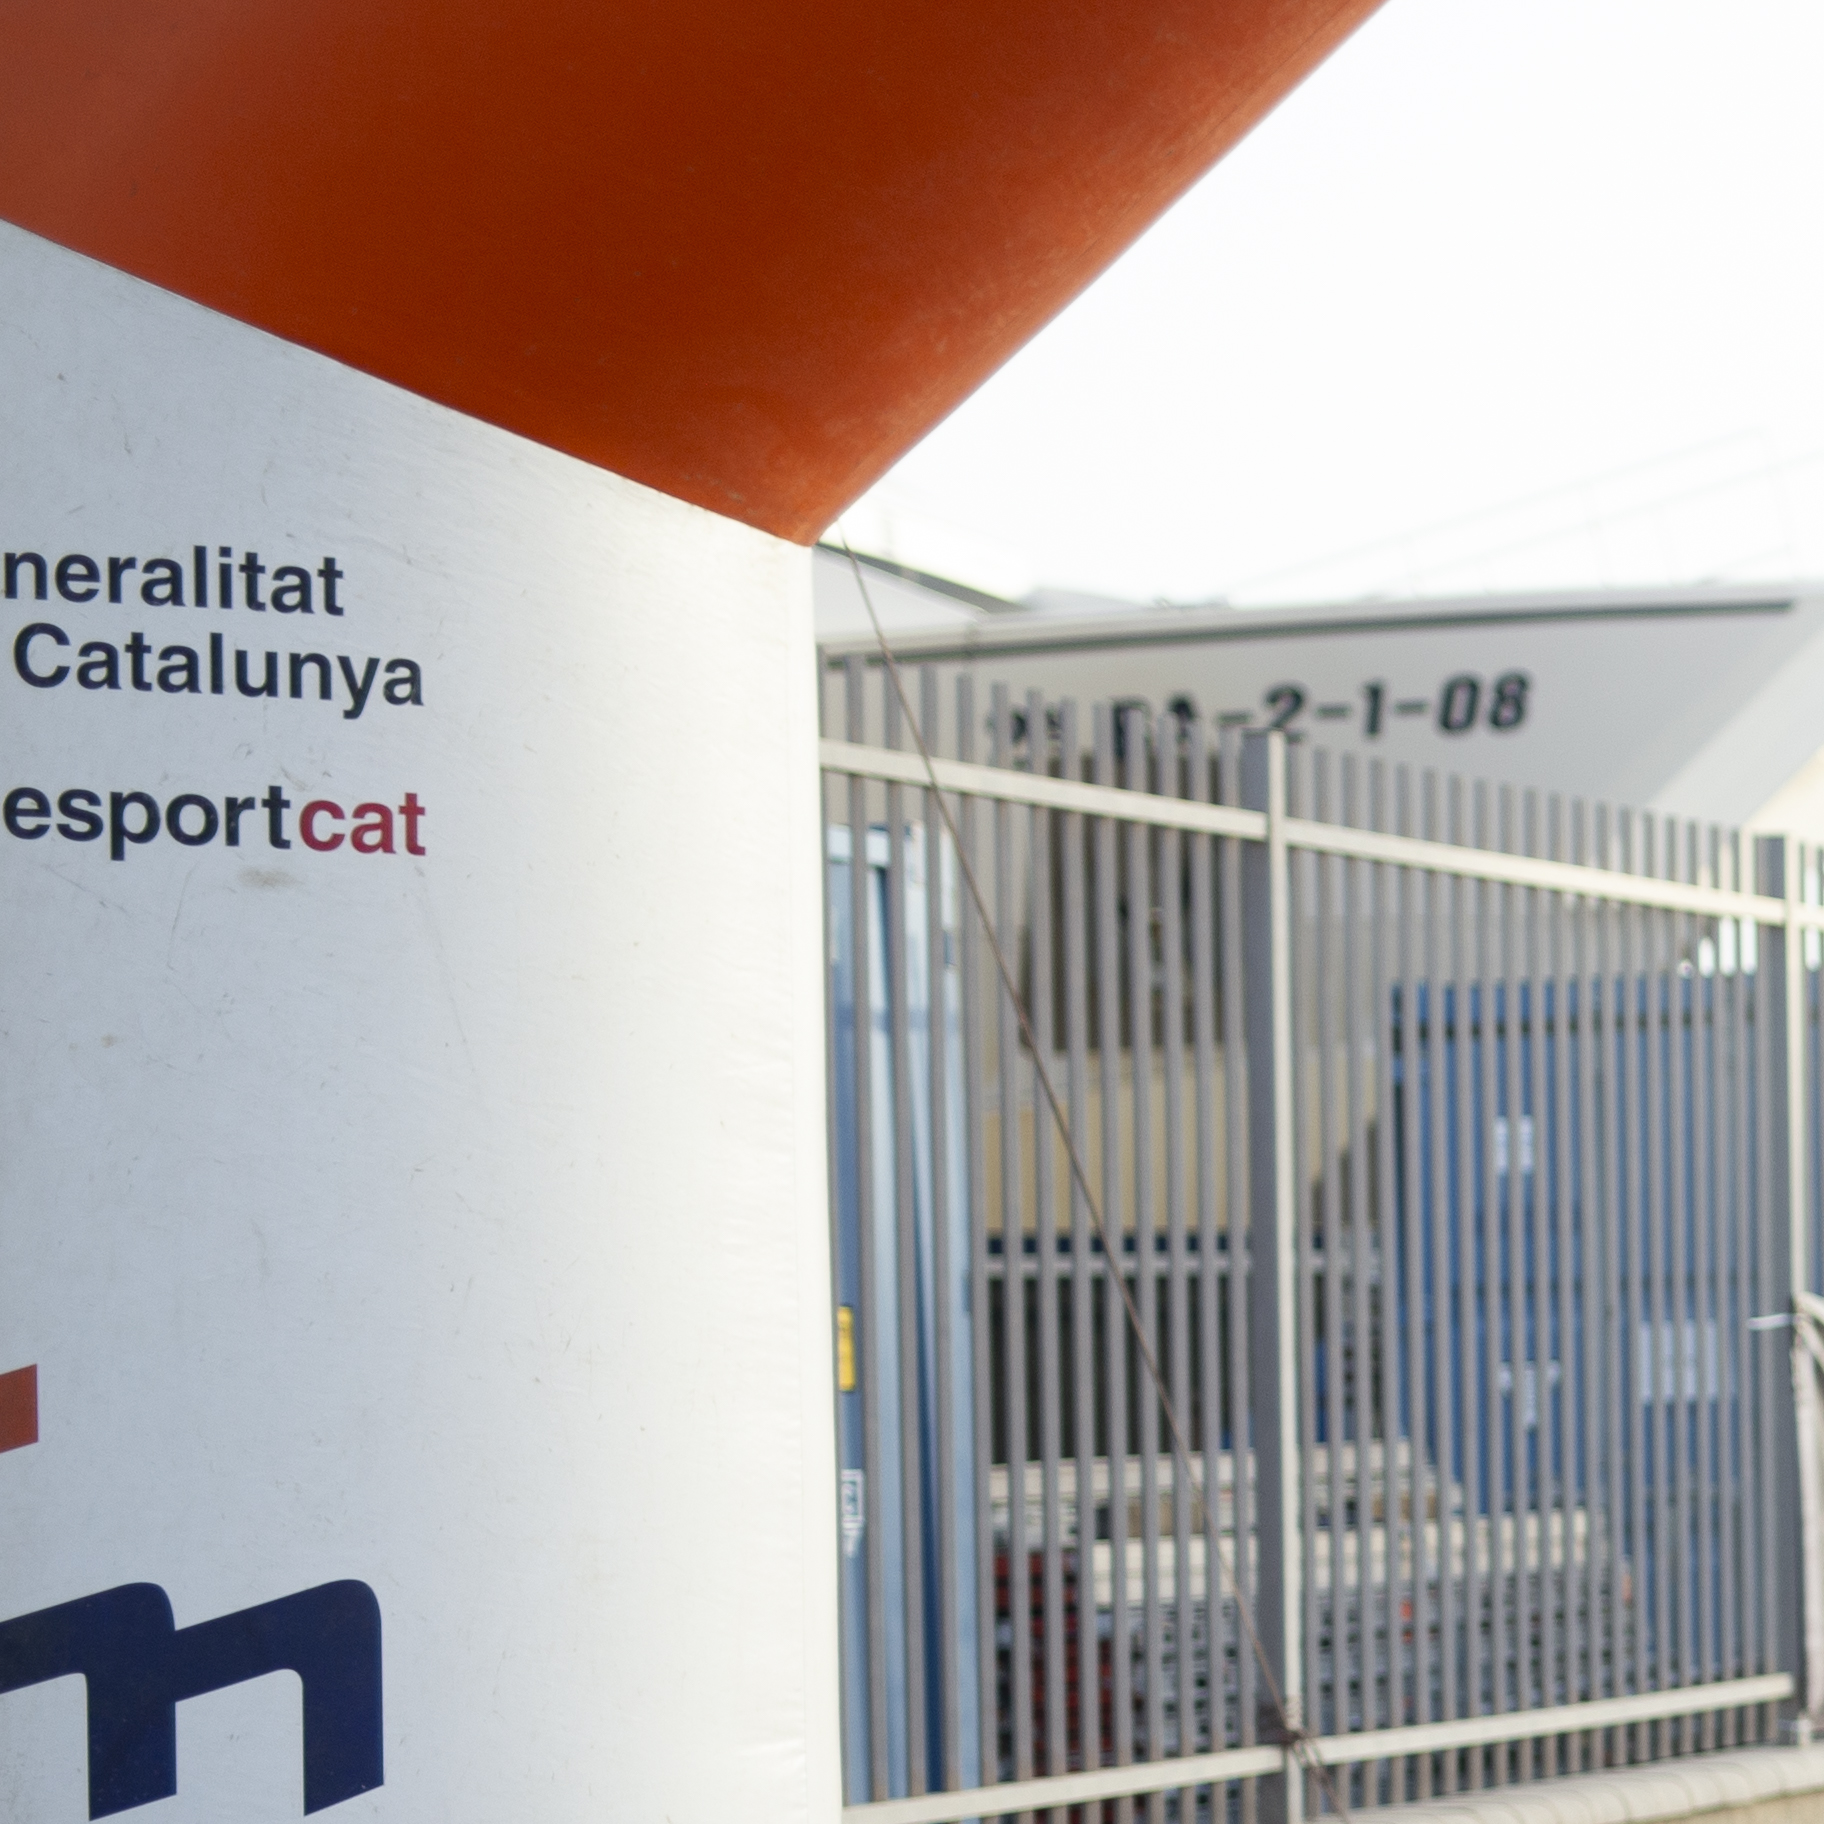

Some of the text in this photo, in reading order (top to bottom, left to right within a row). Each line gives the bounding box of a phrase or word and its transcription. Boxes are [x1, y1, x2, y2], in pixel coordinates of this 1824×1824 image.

[3, 545, 346, 617] neralitat
[12, 622, 425, 720] Catalunya
[3, 783, 428, 862] esportcat
